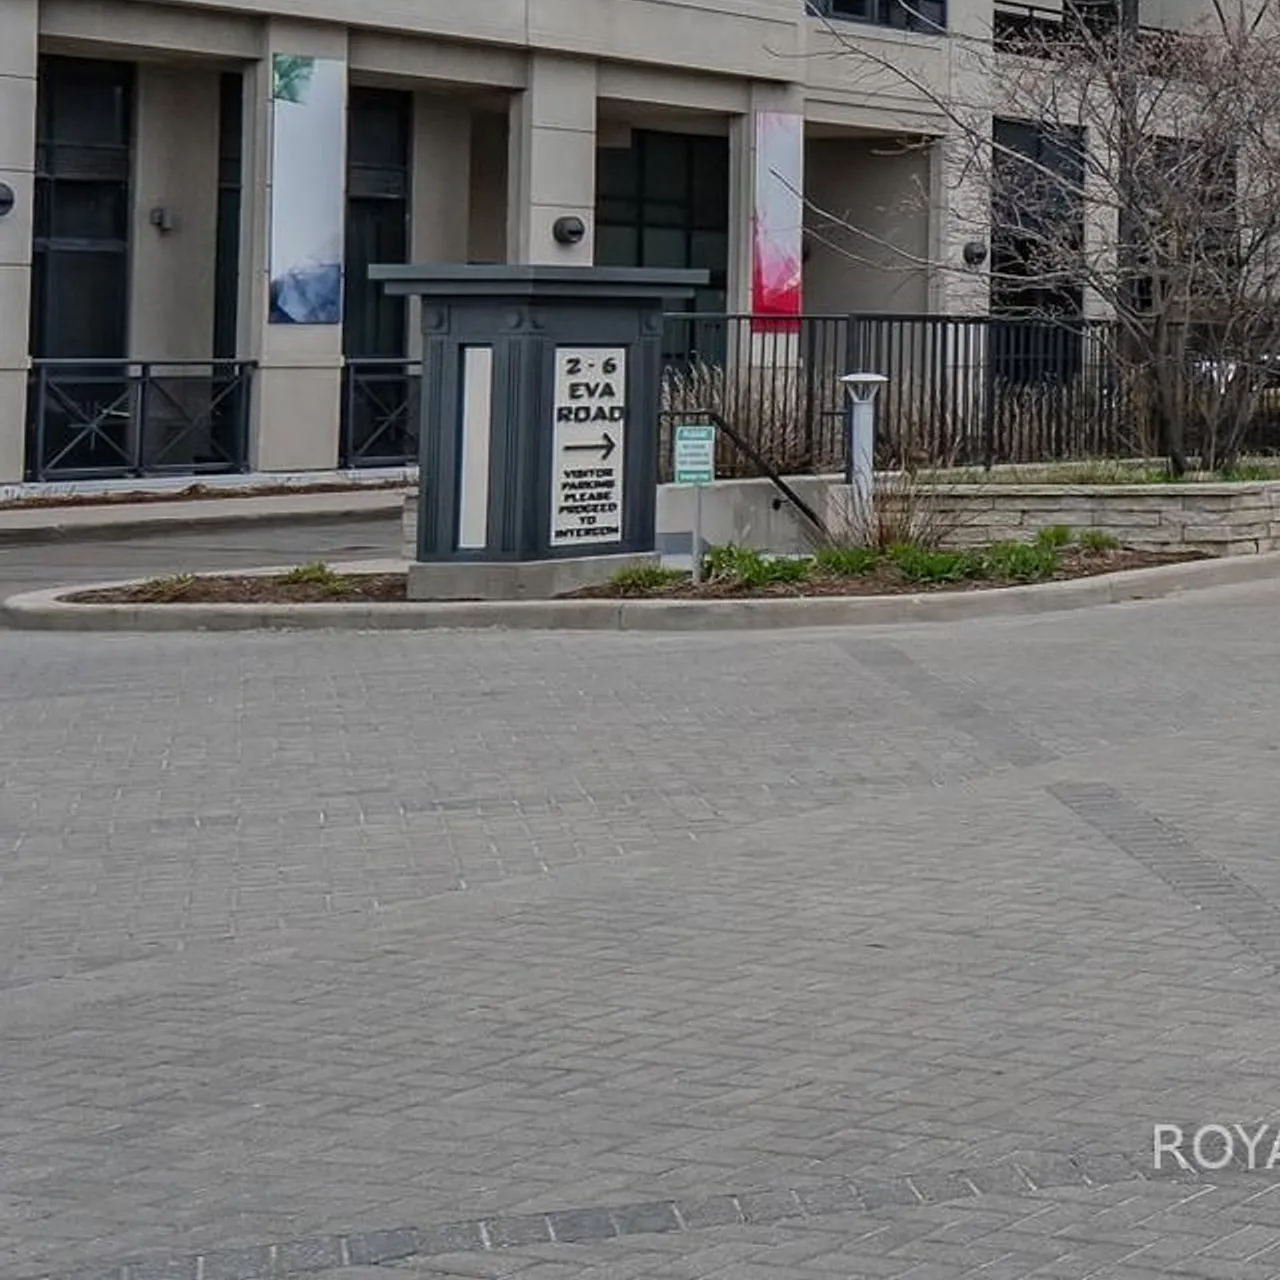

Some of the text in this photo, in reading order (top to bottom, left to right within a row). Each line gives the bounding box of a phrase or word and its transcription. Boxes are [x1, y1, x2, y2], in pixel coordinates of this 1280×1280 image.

[566, 357, 582, 375] 2
[602, 357, 617, 374] 6
[569, 381, 616, 400] EVA
[557, 405, 626, 423] ROAD
[563, 468, 614, 479] VISITOR
[561, 480, 616, 491] PARKING
[564, 491, 612, 503] PLEASE
[558, 503, 618, 515] PROCEED
[579, 515, 597, 525] TO
[554, 526, 620, 538] INTERCOM
